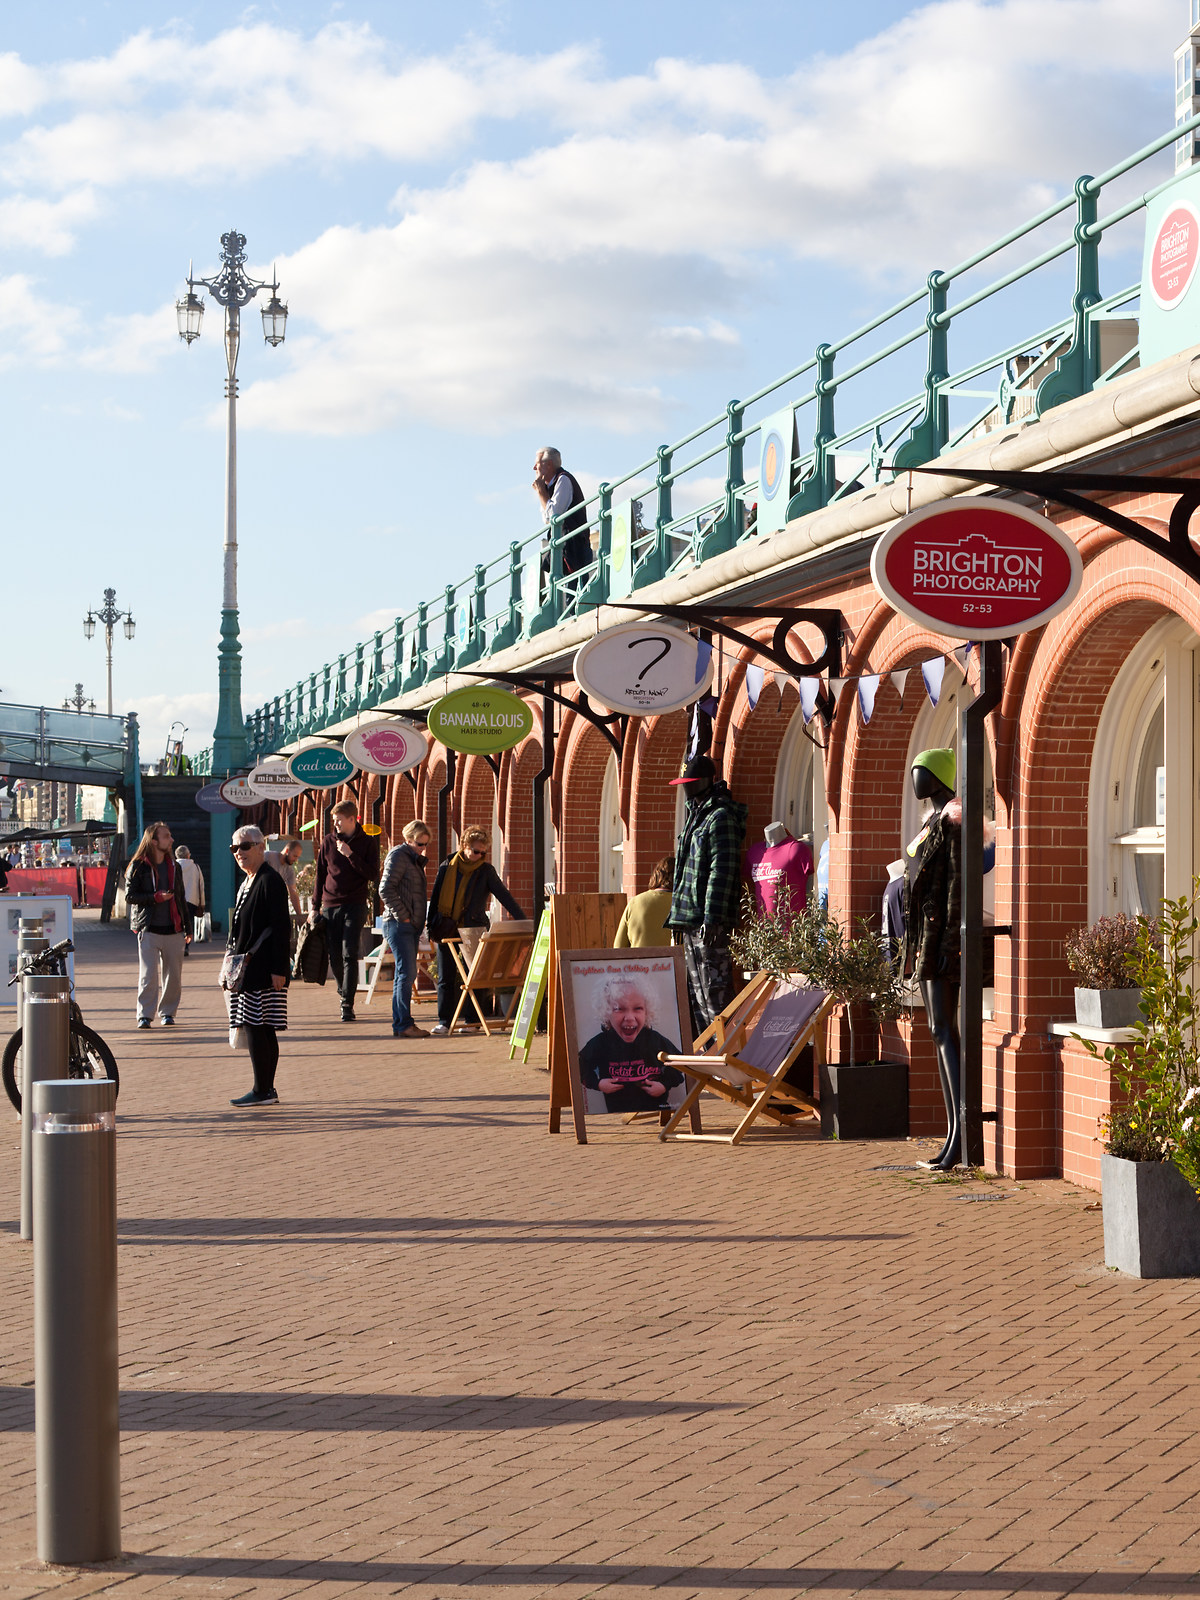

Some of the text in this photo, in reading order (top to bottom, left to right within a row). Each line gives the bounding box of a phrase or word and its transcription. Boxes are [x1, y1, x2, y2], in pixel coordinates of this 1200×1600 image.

[1160, 227, 1189, 253] BRIGHTON
[1160, 241, 1188, 263] PHOTOGRAPHY
[913, 549, 1042, 577] BRIGHTON
[913, 573, 1041, 593] PHOTOGRAPHY
[962, 603, 992, 613] 52-53
[440, 712, 524, 728] BANANA LOUIS
[257, 774, 294, 783] mia beac
